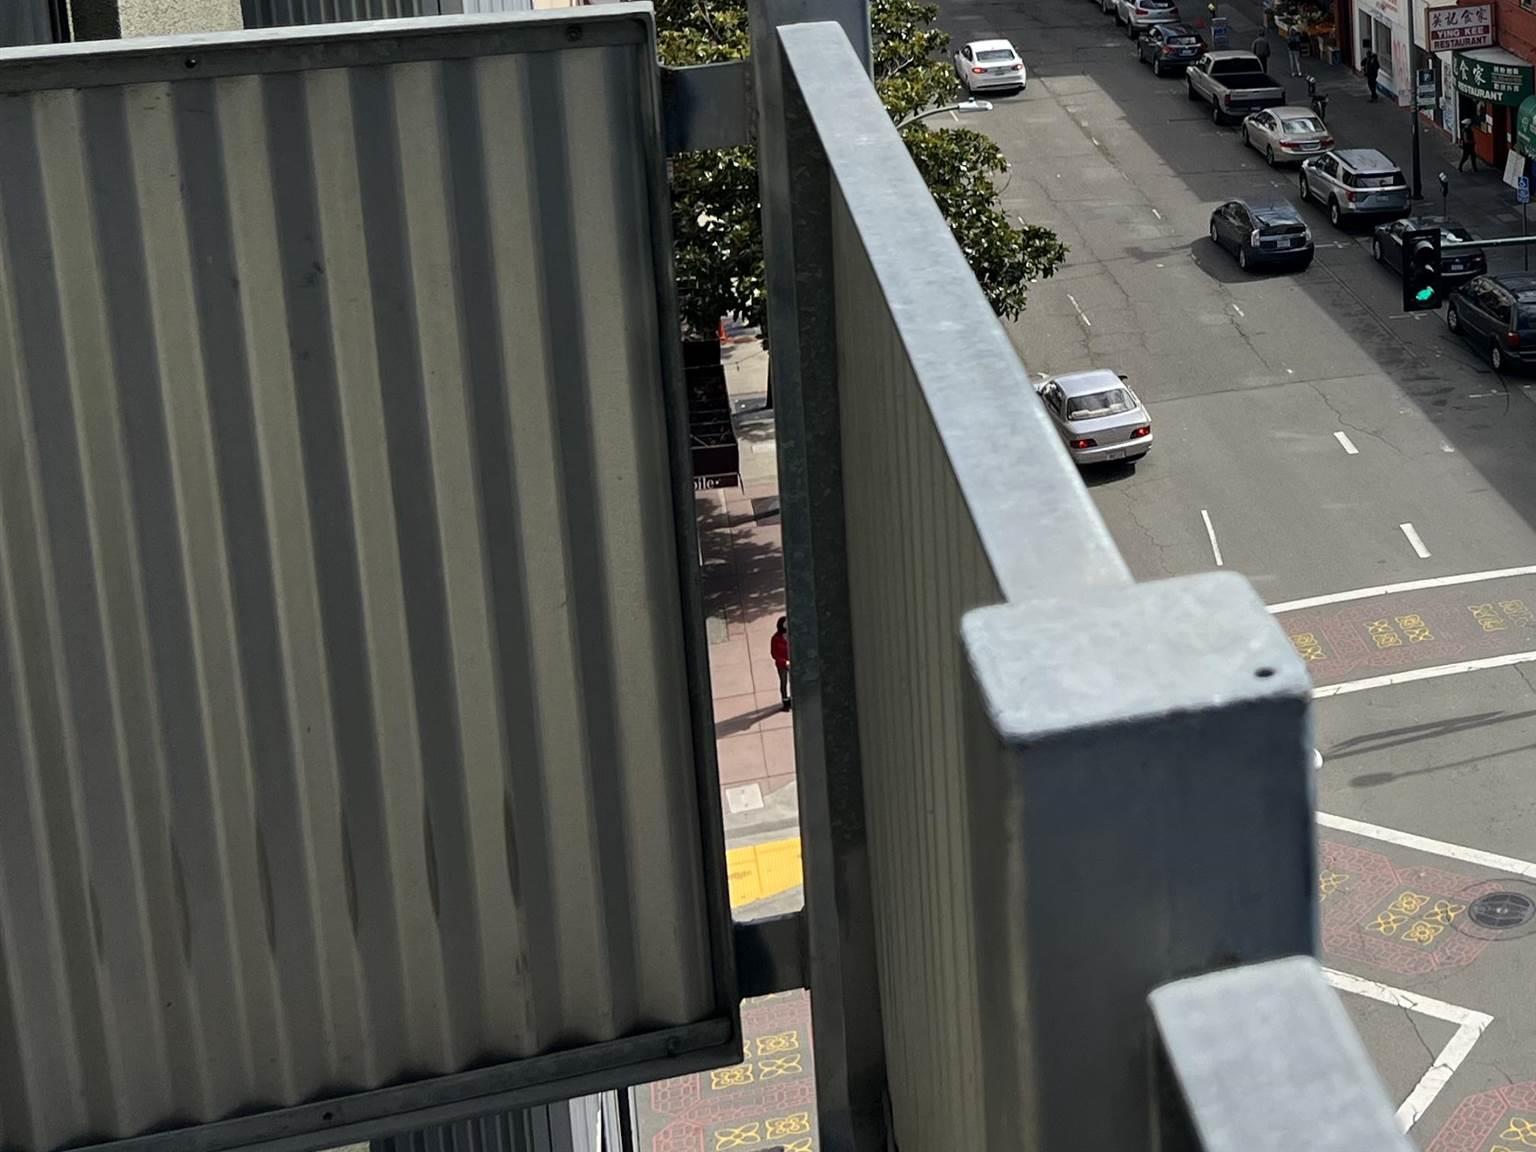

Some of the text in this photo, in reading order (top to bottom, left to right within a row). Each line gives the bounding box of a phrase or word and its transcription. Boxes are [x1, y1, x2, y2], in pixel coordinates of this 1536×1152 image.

[1437, 26, 1484, 38] YING KEE
[1434, 36, 1487, 49] RESTAURANT
